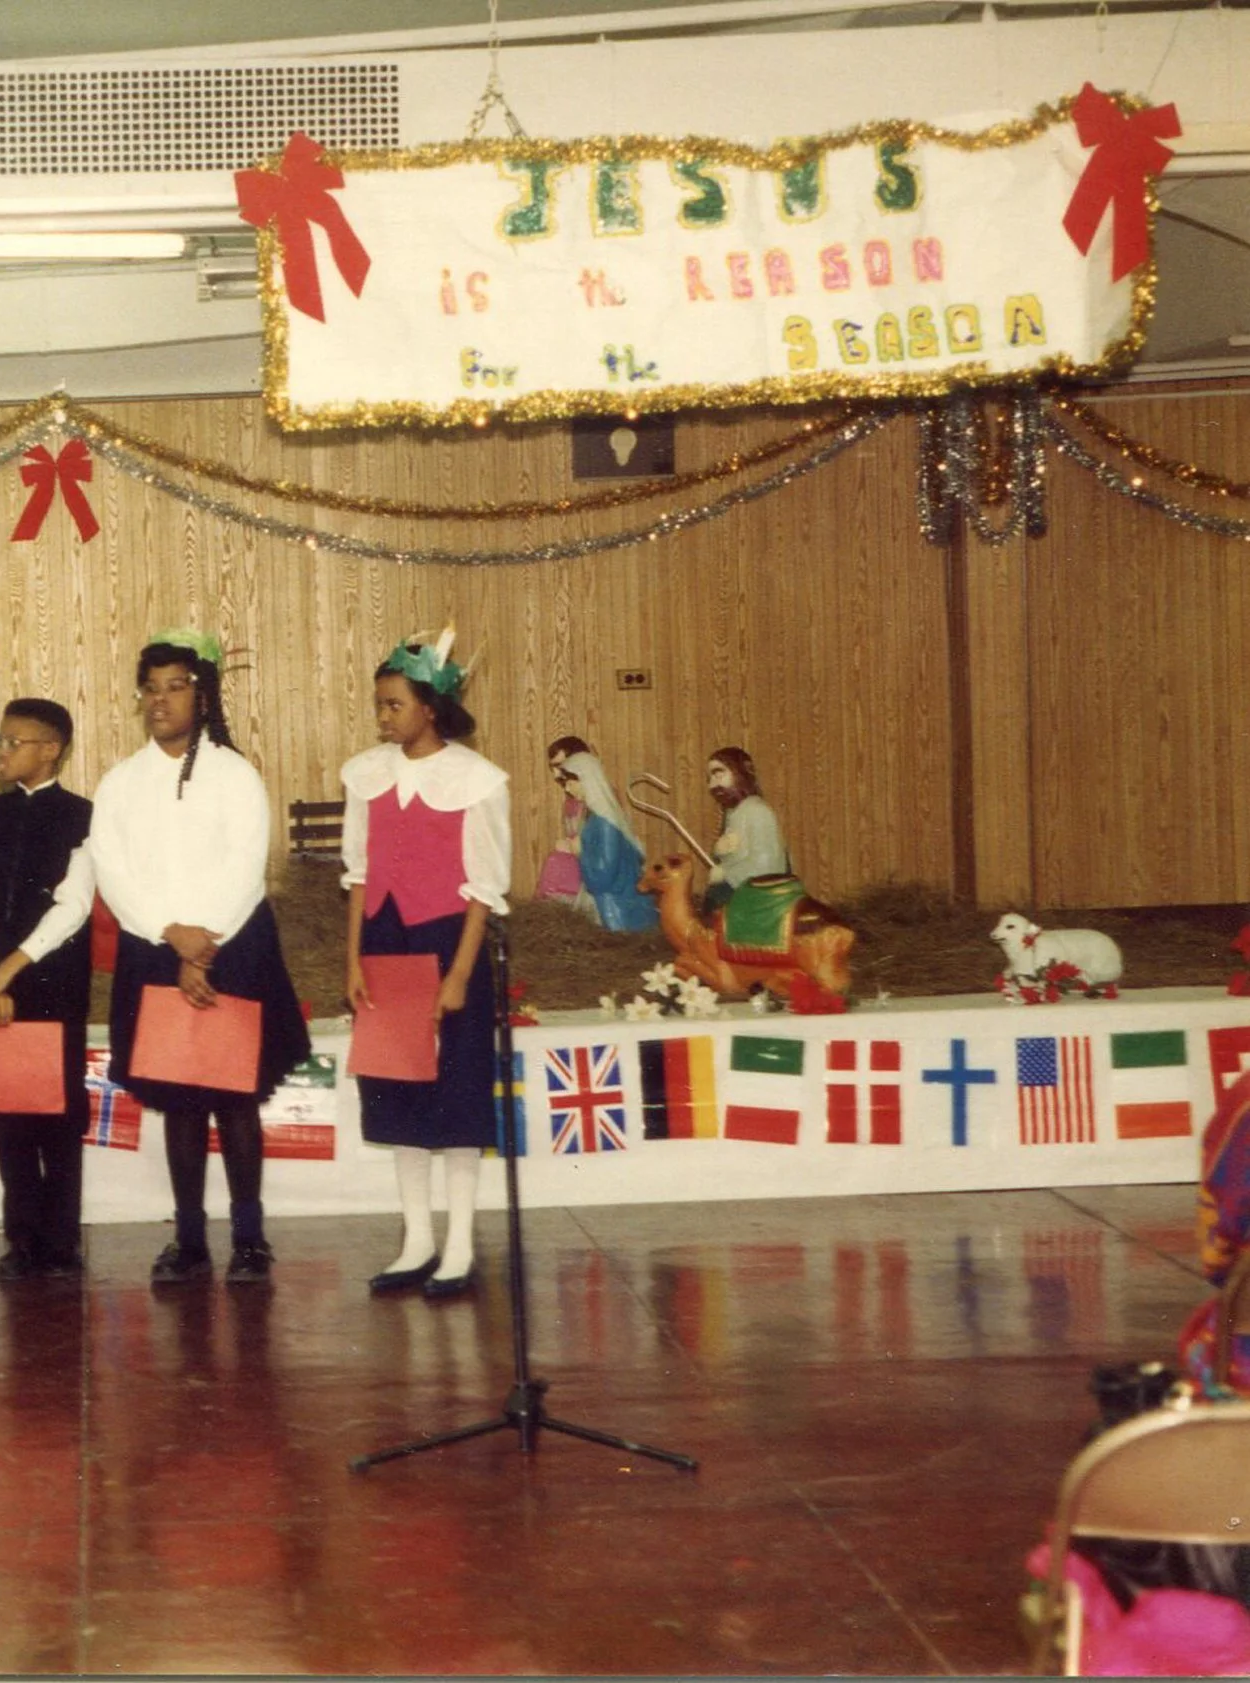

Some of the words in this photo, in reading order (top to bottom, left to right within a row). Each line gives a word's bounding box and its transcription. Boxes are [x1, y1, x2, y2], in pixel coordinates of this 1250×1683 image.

[495, 138, 927, 243] JESUS
[684, 236, 944, 302] REASON
[600, 343, 661, 383] the
[781, 293, 1047, 370] SEASON
